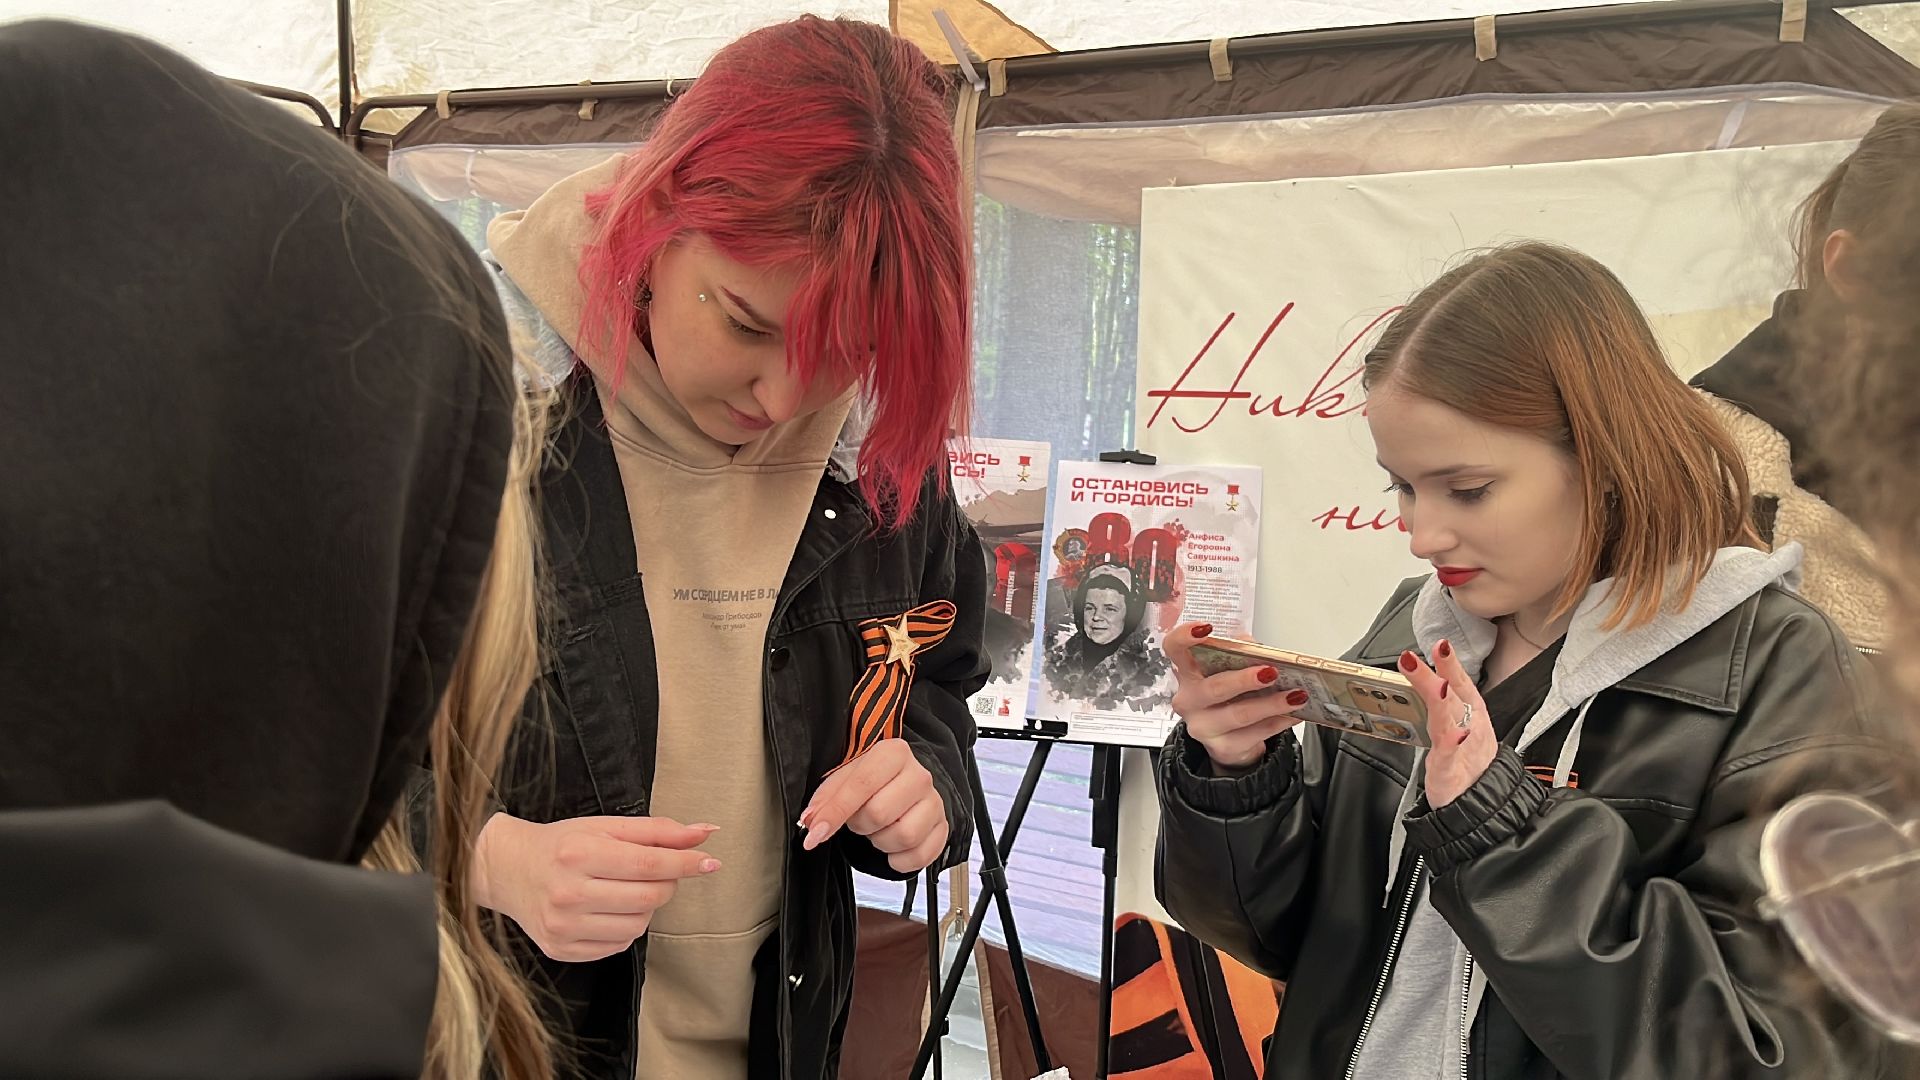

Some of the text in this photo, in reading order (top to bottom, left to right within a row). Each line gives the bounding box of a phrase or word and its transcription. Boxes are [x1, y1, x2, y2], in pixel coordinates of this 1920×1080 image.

[1072, 477, 1209, 495] ОСТАНОВИСЬ
[1071, 491, 1193, 508] И ГОРДИСЬ!
[1189, 533, 1225, 542] Анфиса
[1188, 542, 1231, 552] Егоровна
[1187, 552, 1240, 562] Савушкина
[1187, 564, 1223, 573] 1913-1988
[673, 588, 689, 600] УМ
[740, 589, 756, 601] НЕ
[757, 588, 765, 599] В
